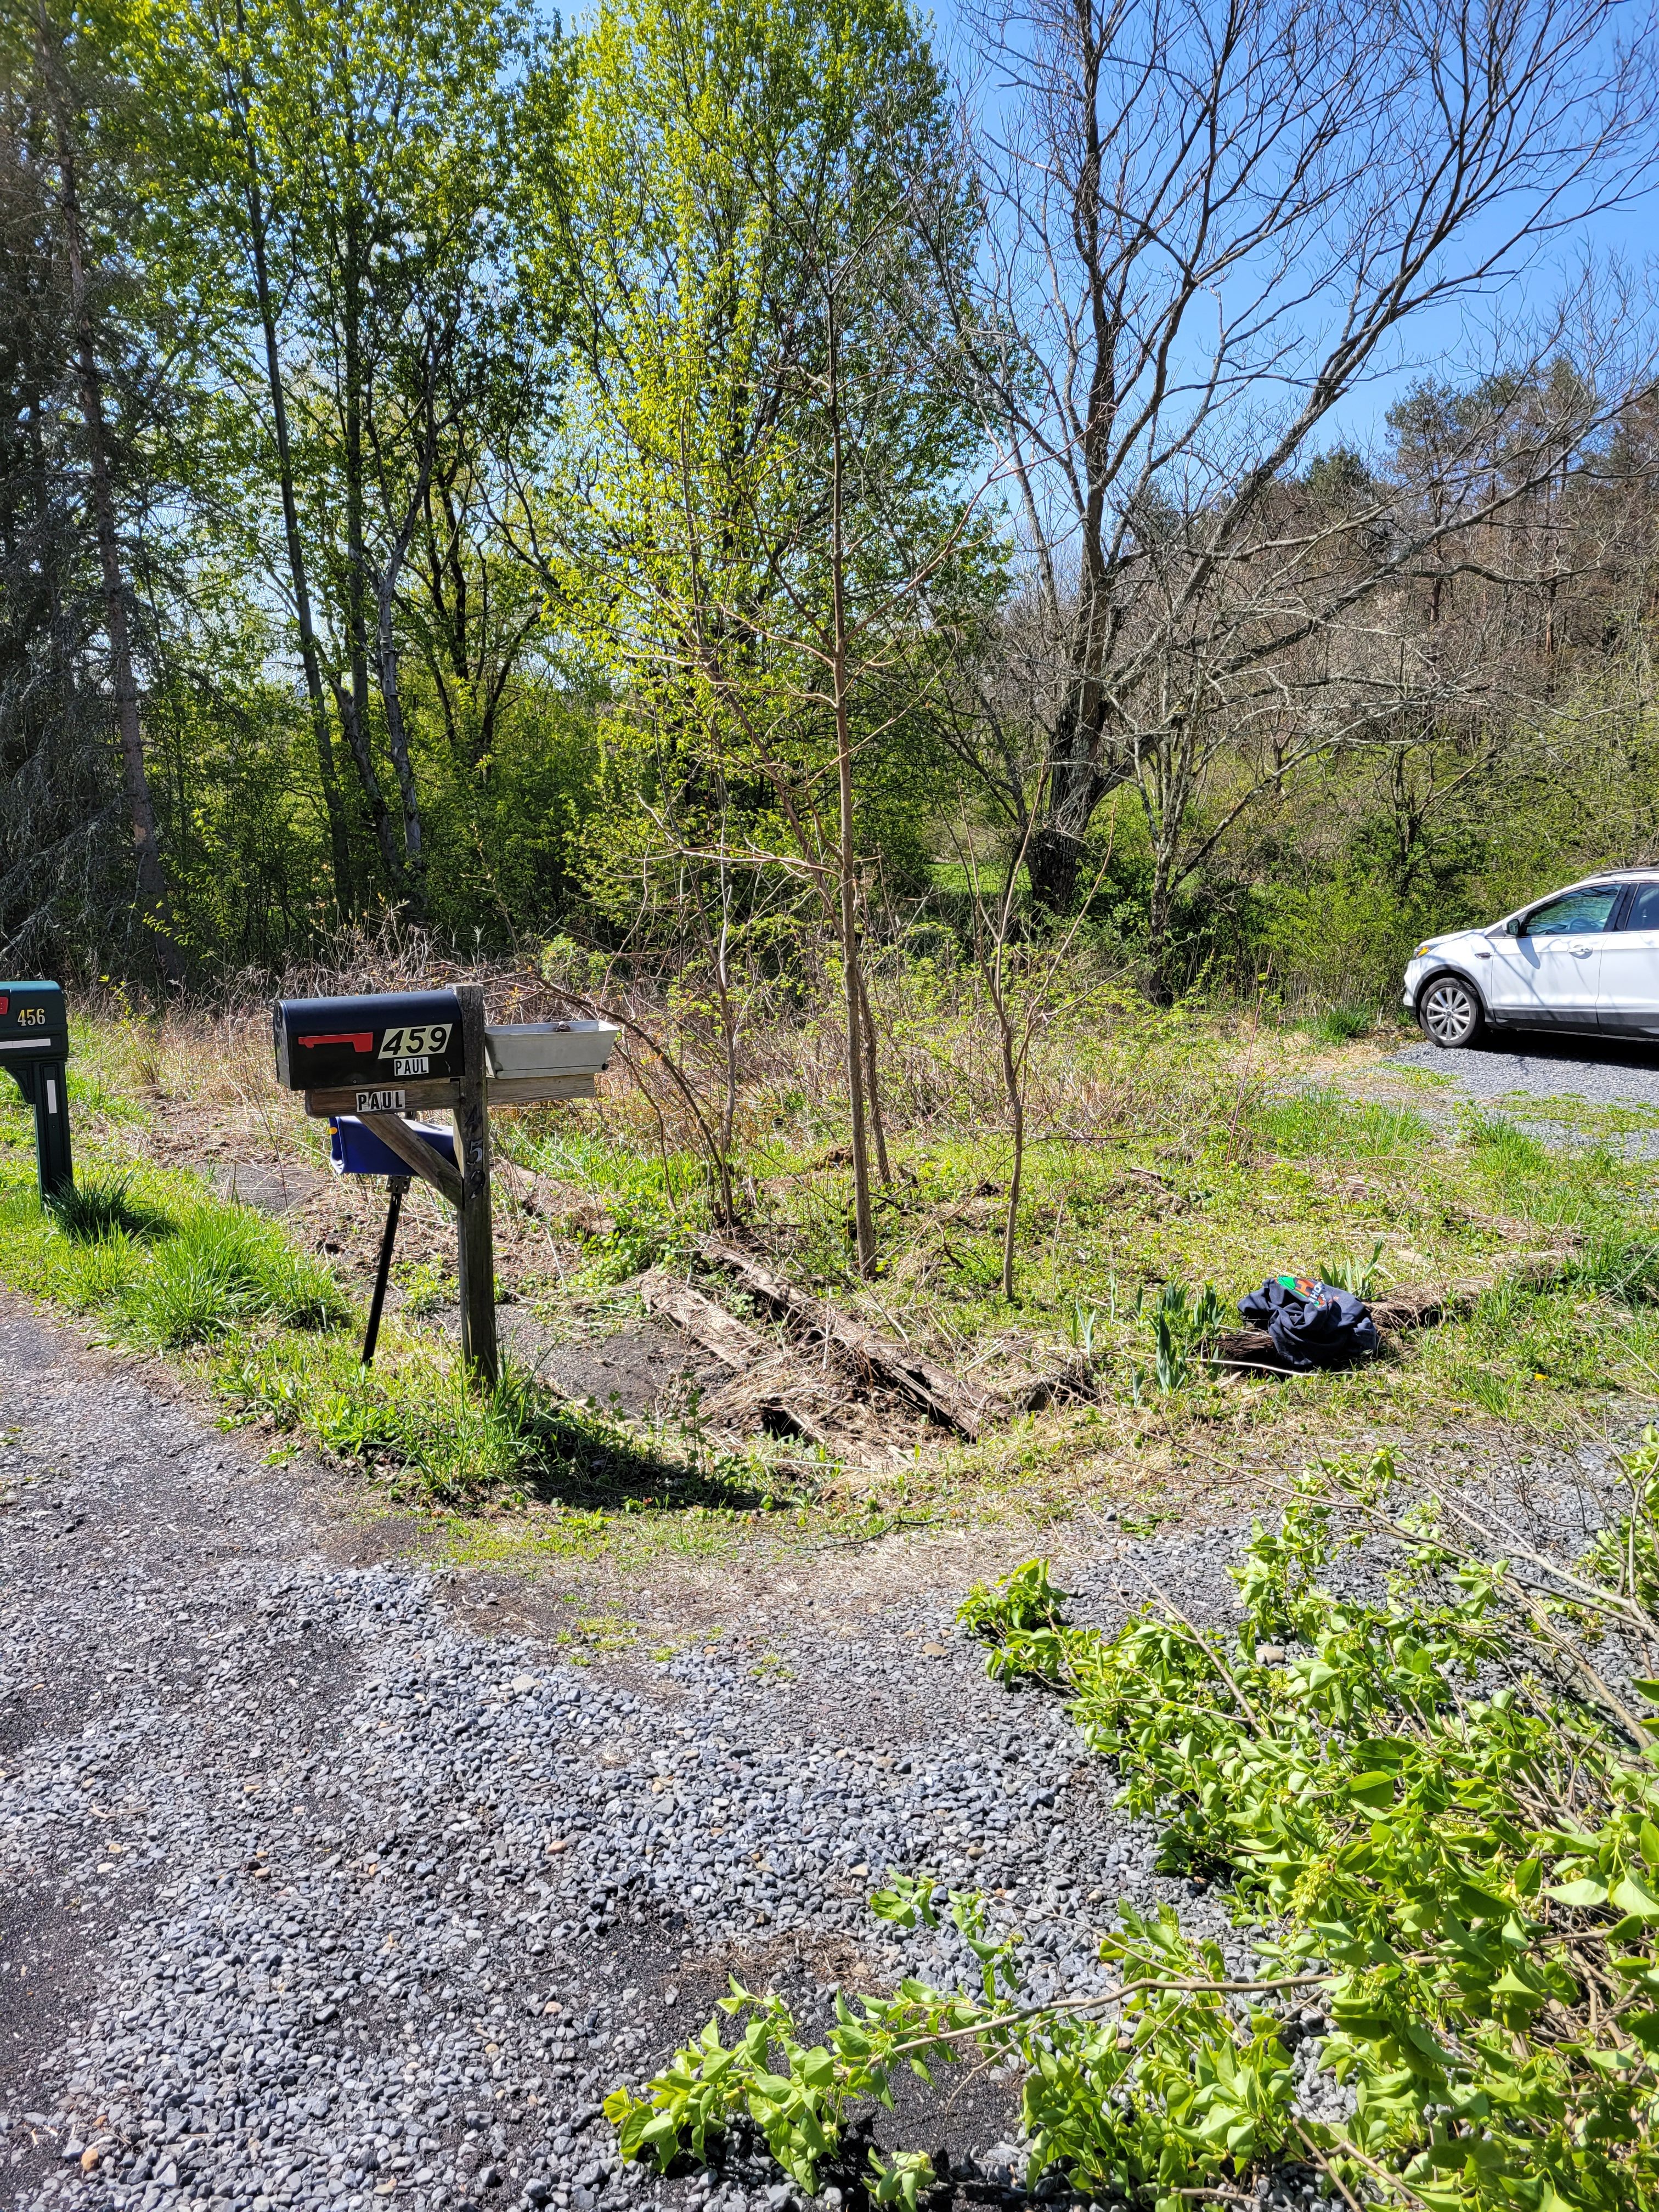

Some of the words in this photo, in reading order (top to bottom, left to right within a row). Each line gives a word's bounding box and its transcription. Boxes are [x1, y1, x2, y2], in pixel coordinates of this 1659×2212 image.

[17, 1008, 46, 1026] 456
[382, 1026, 447, 1056] 459
[395, 1058, 427, 1075] PAUL
[358, 1091, 403, 1111] PAUL
